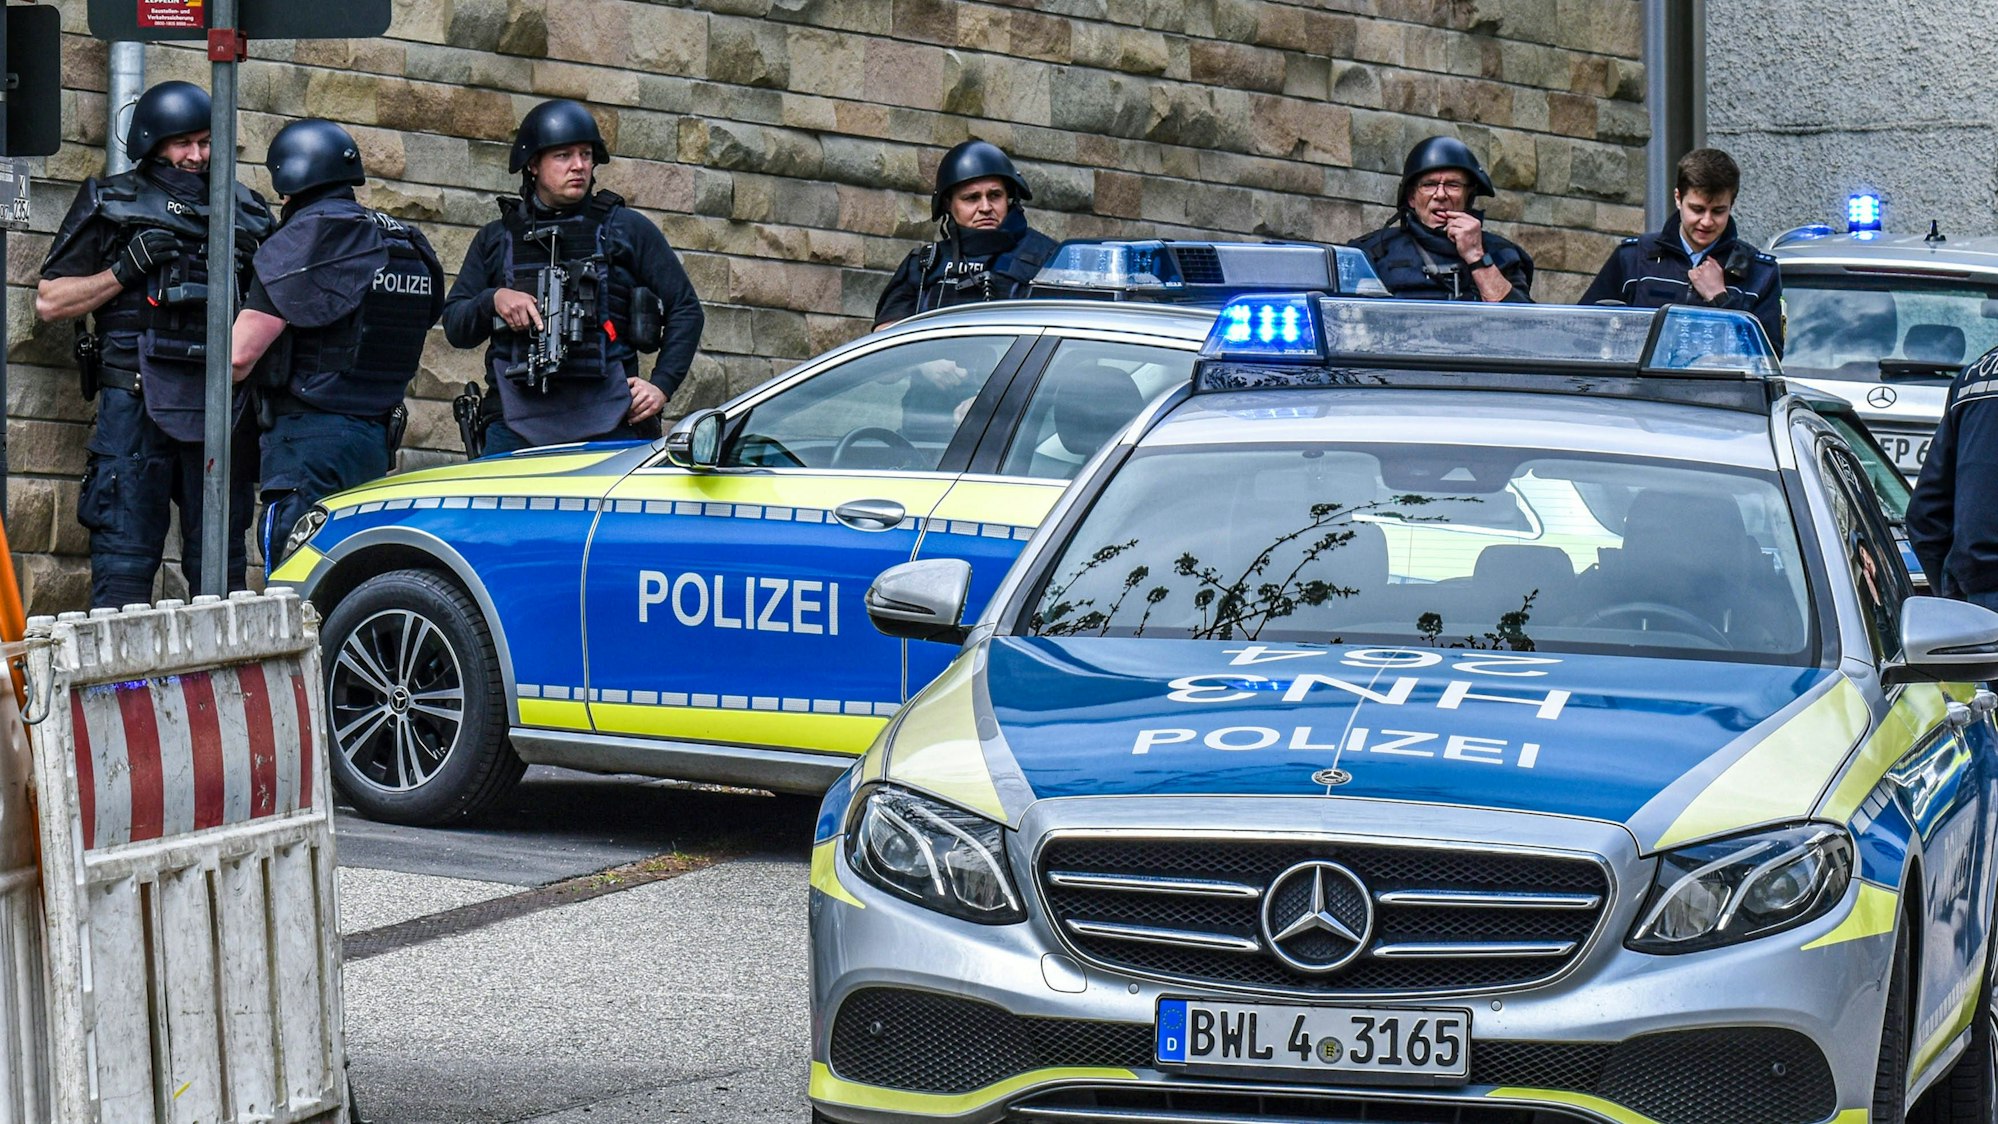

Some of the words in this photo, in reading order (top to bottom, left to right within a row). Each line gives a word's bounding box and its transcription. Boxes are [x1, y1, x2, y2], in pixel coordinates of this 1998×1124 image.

[372, 272, 432, 295] POLIZEI
[944, 261, 984, 274] PLIZEI
[638, 569, 839, 636] POLIZEI
[1222, 646, 1564, 677] 264
[1167, 674, 1571, 720] HN3
[1131, 726, 1540, 768] POLIZEI
[1166, 1037, 1178, 1052] D
[1190, 1008, 1273, 1061] BWL
[1287, 1014, 1312, 1061] 4
[1349, 1016, 1460, 1067] 3165
